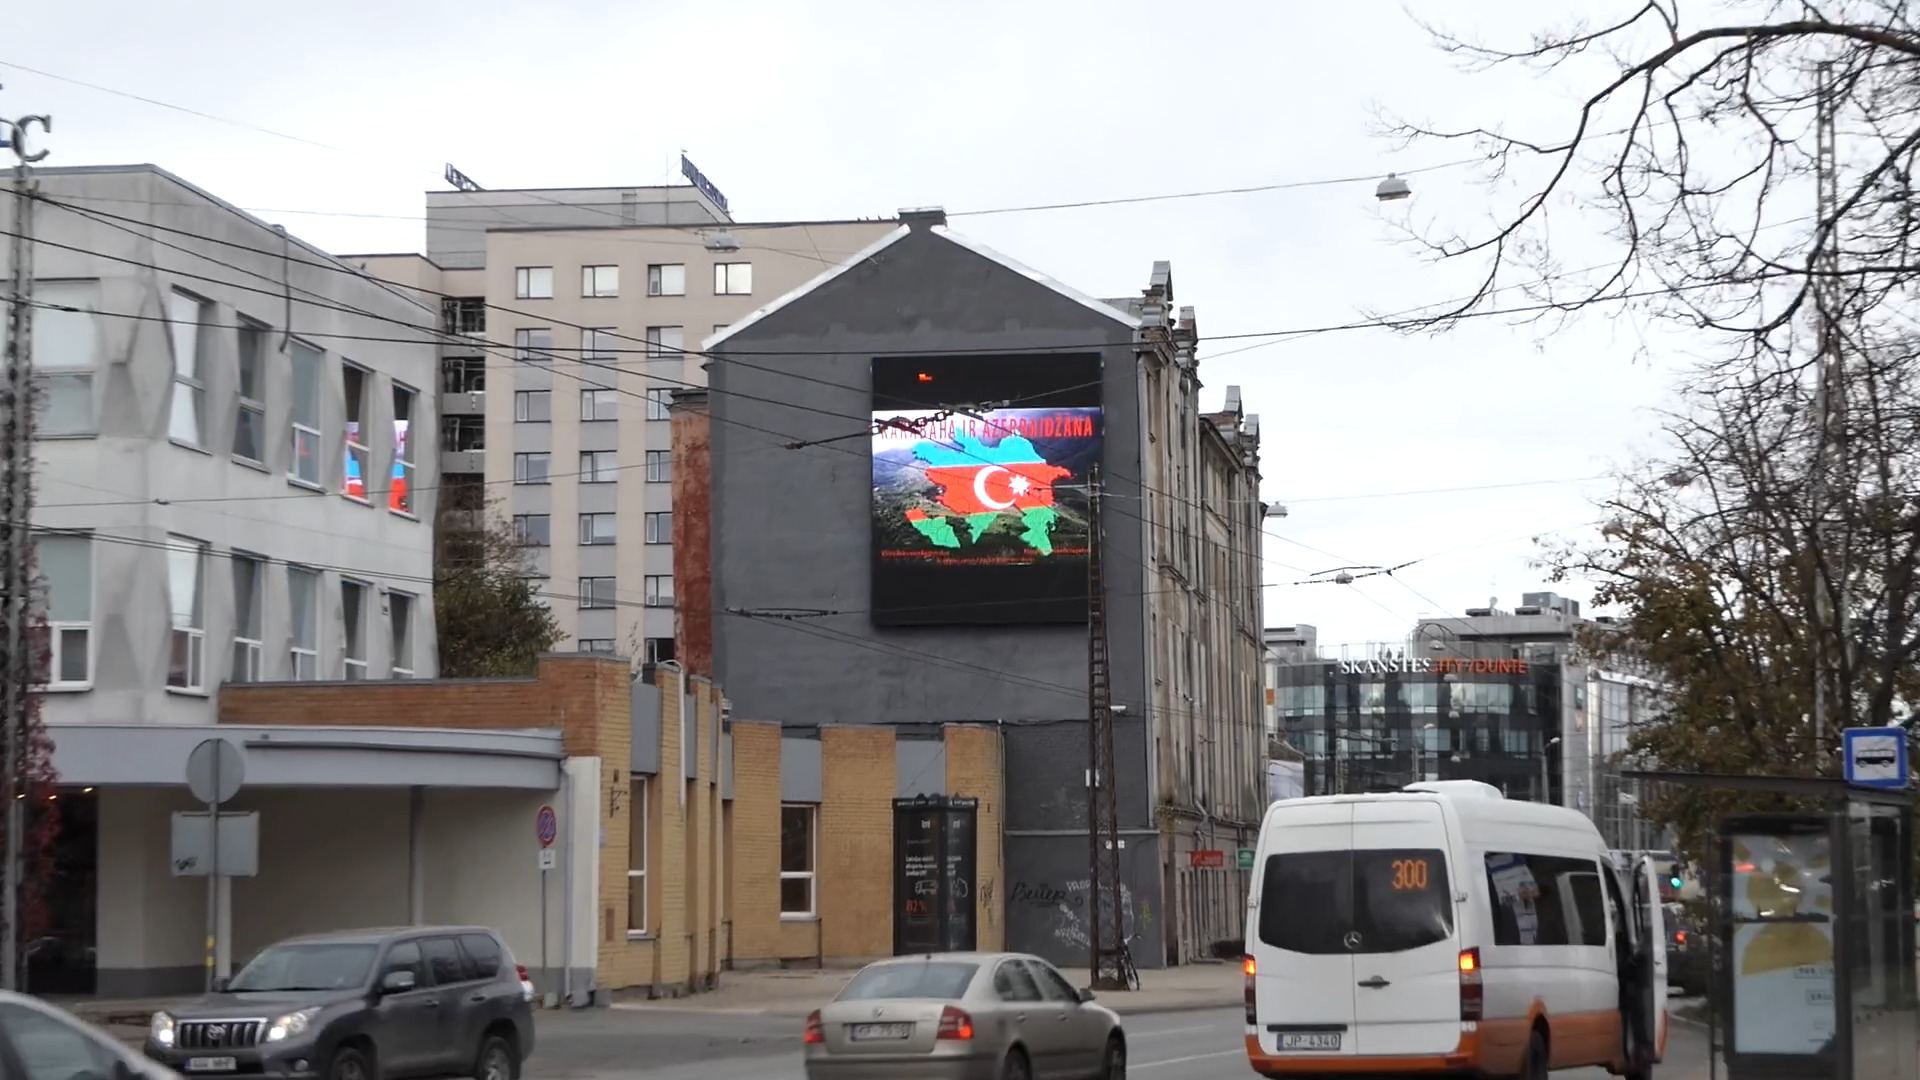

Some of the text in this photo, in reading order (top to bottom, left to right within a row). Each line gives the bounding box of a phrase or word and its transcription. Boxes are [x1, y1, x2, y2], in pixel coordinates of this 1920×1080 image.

[963, 419, 976, 437] IR
[1341, 657, 1432, 674] SKANSTES
[1392, 860, 1427, 889] 300
